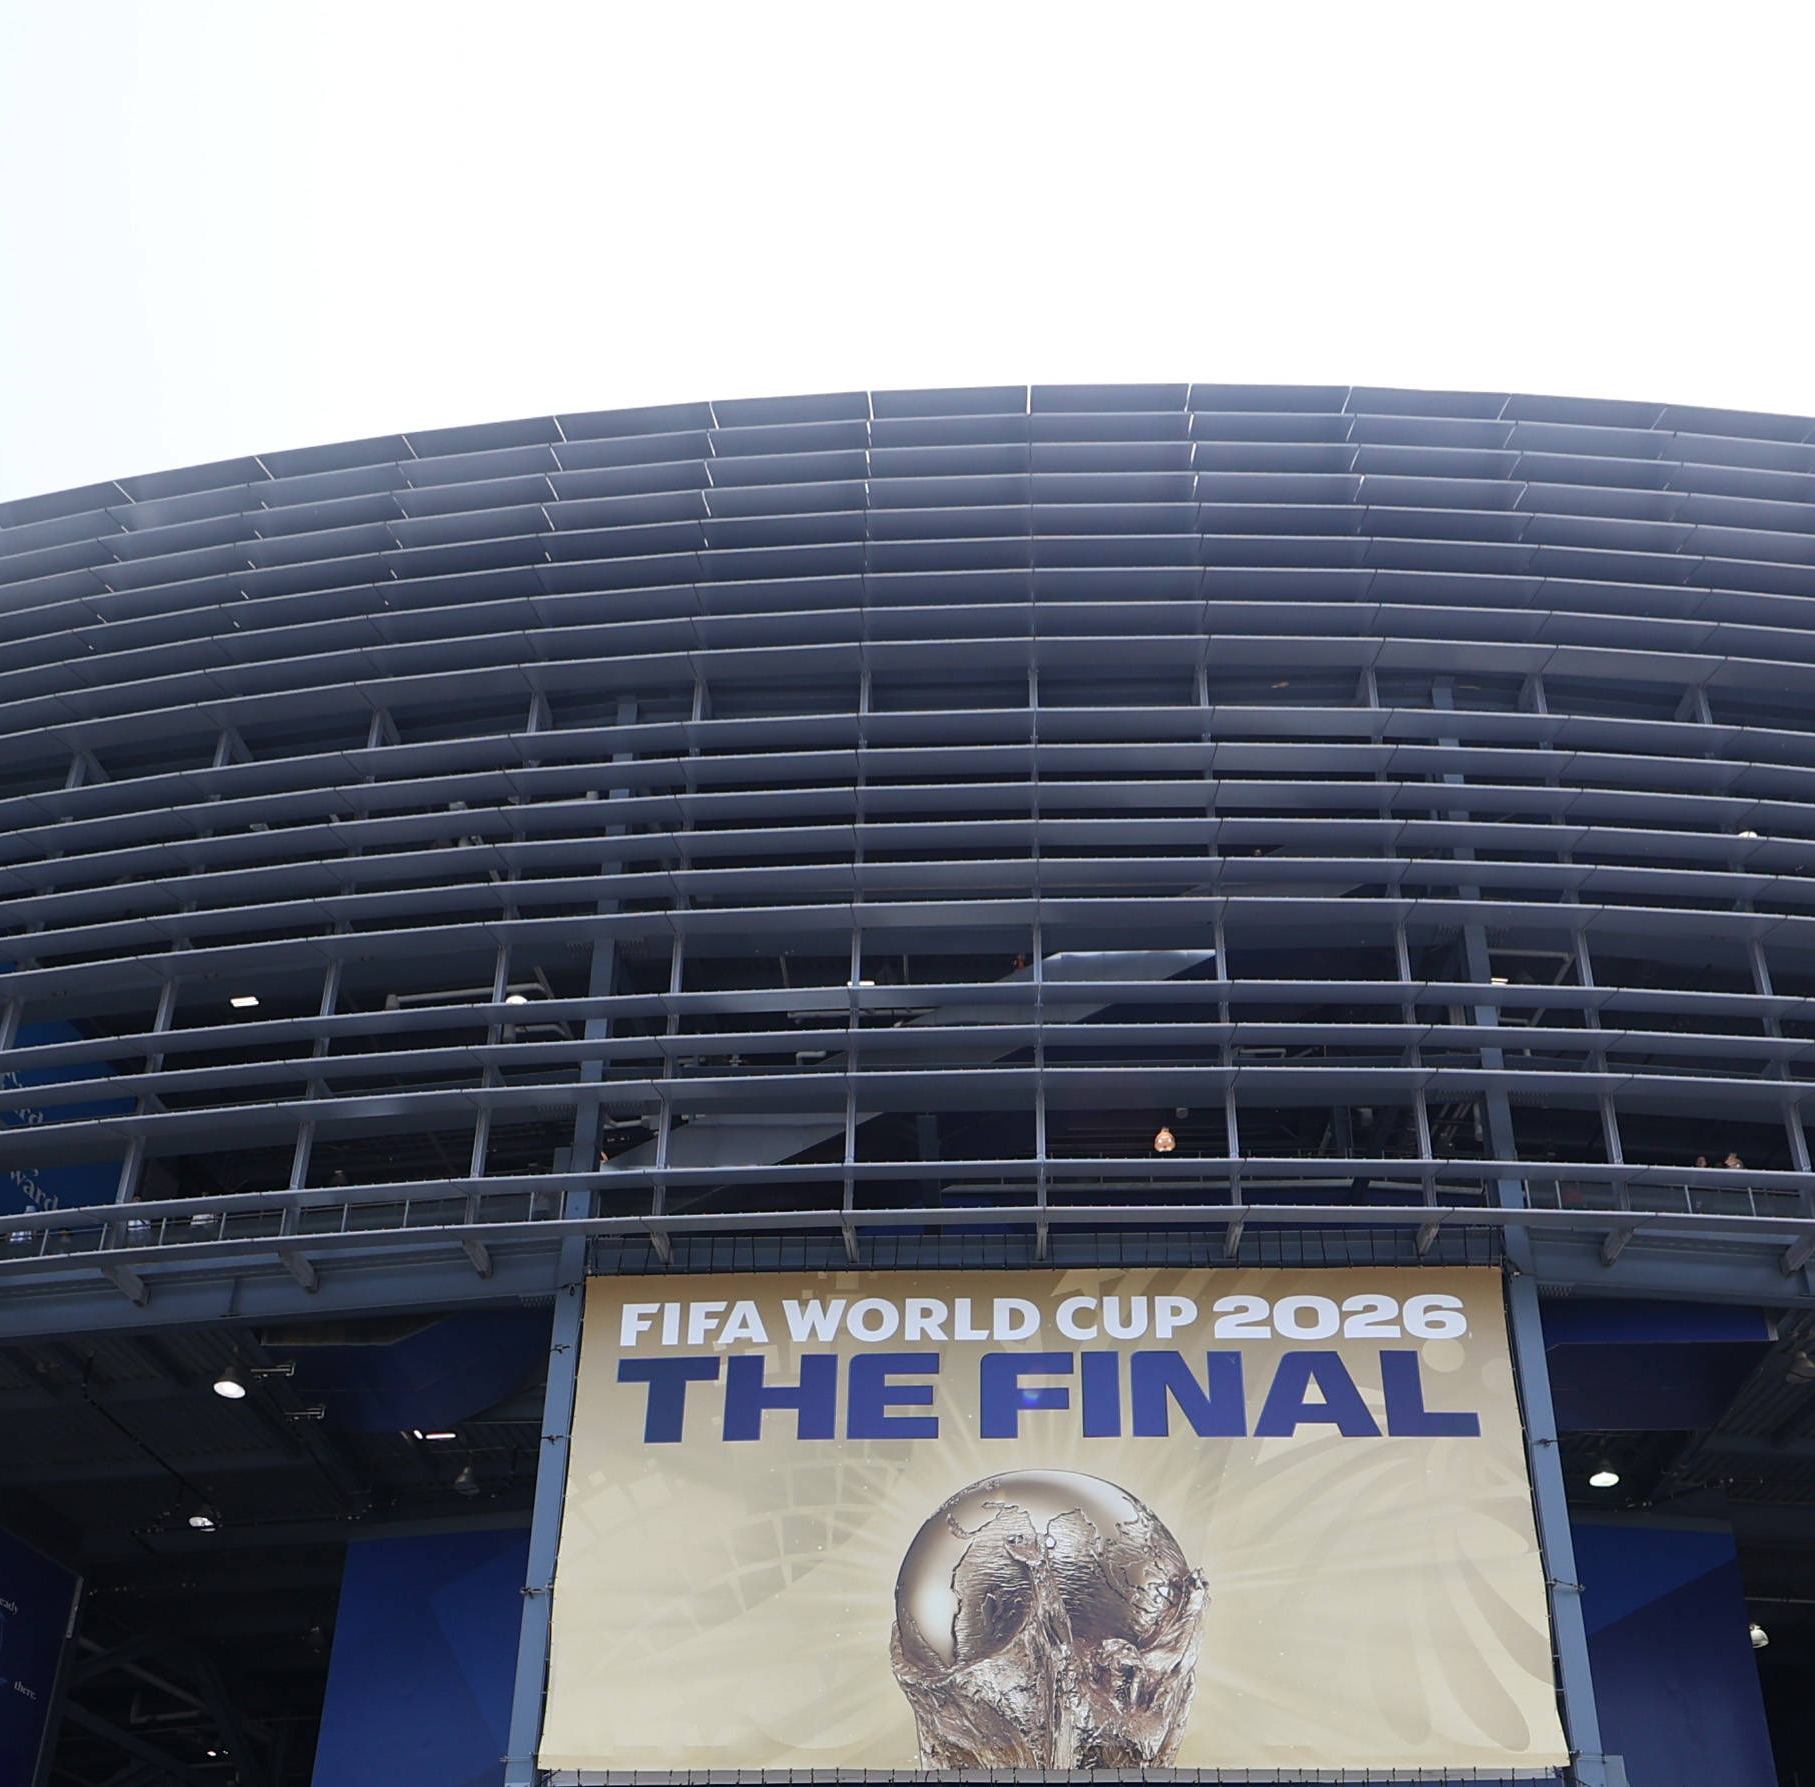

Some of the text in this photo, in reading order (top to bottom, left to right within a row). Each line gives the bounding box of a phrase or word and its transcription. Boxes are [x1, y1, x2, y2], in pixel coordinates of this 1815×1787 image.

[620, 1293, 1467, 1347] FIFA WORLD CUP 2026
[617, 1349, 1481, 1443] THE FINAL
[14, 1680, 38, 1701] there.
